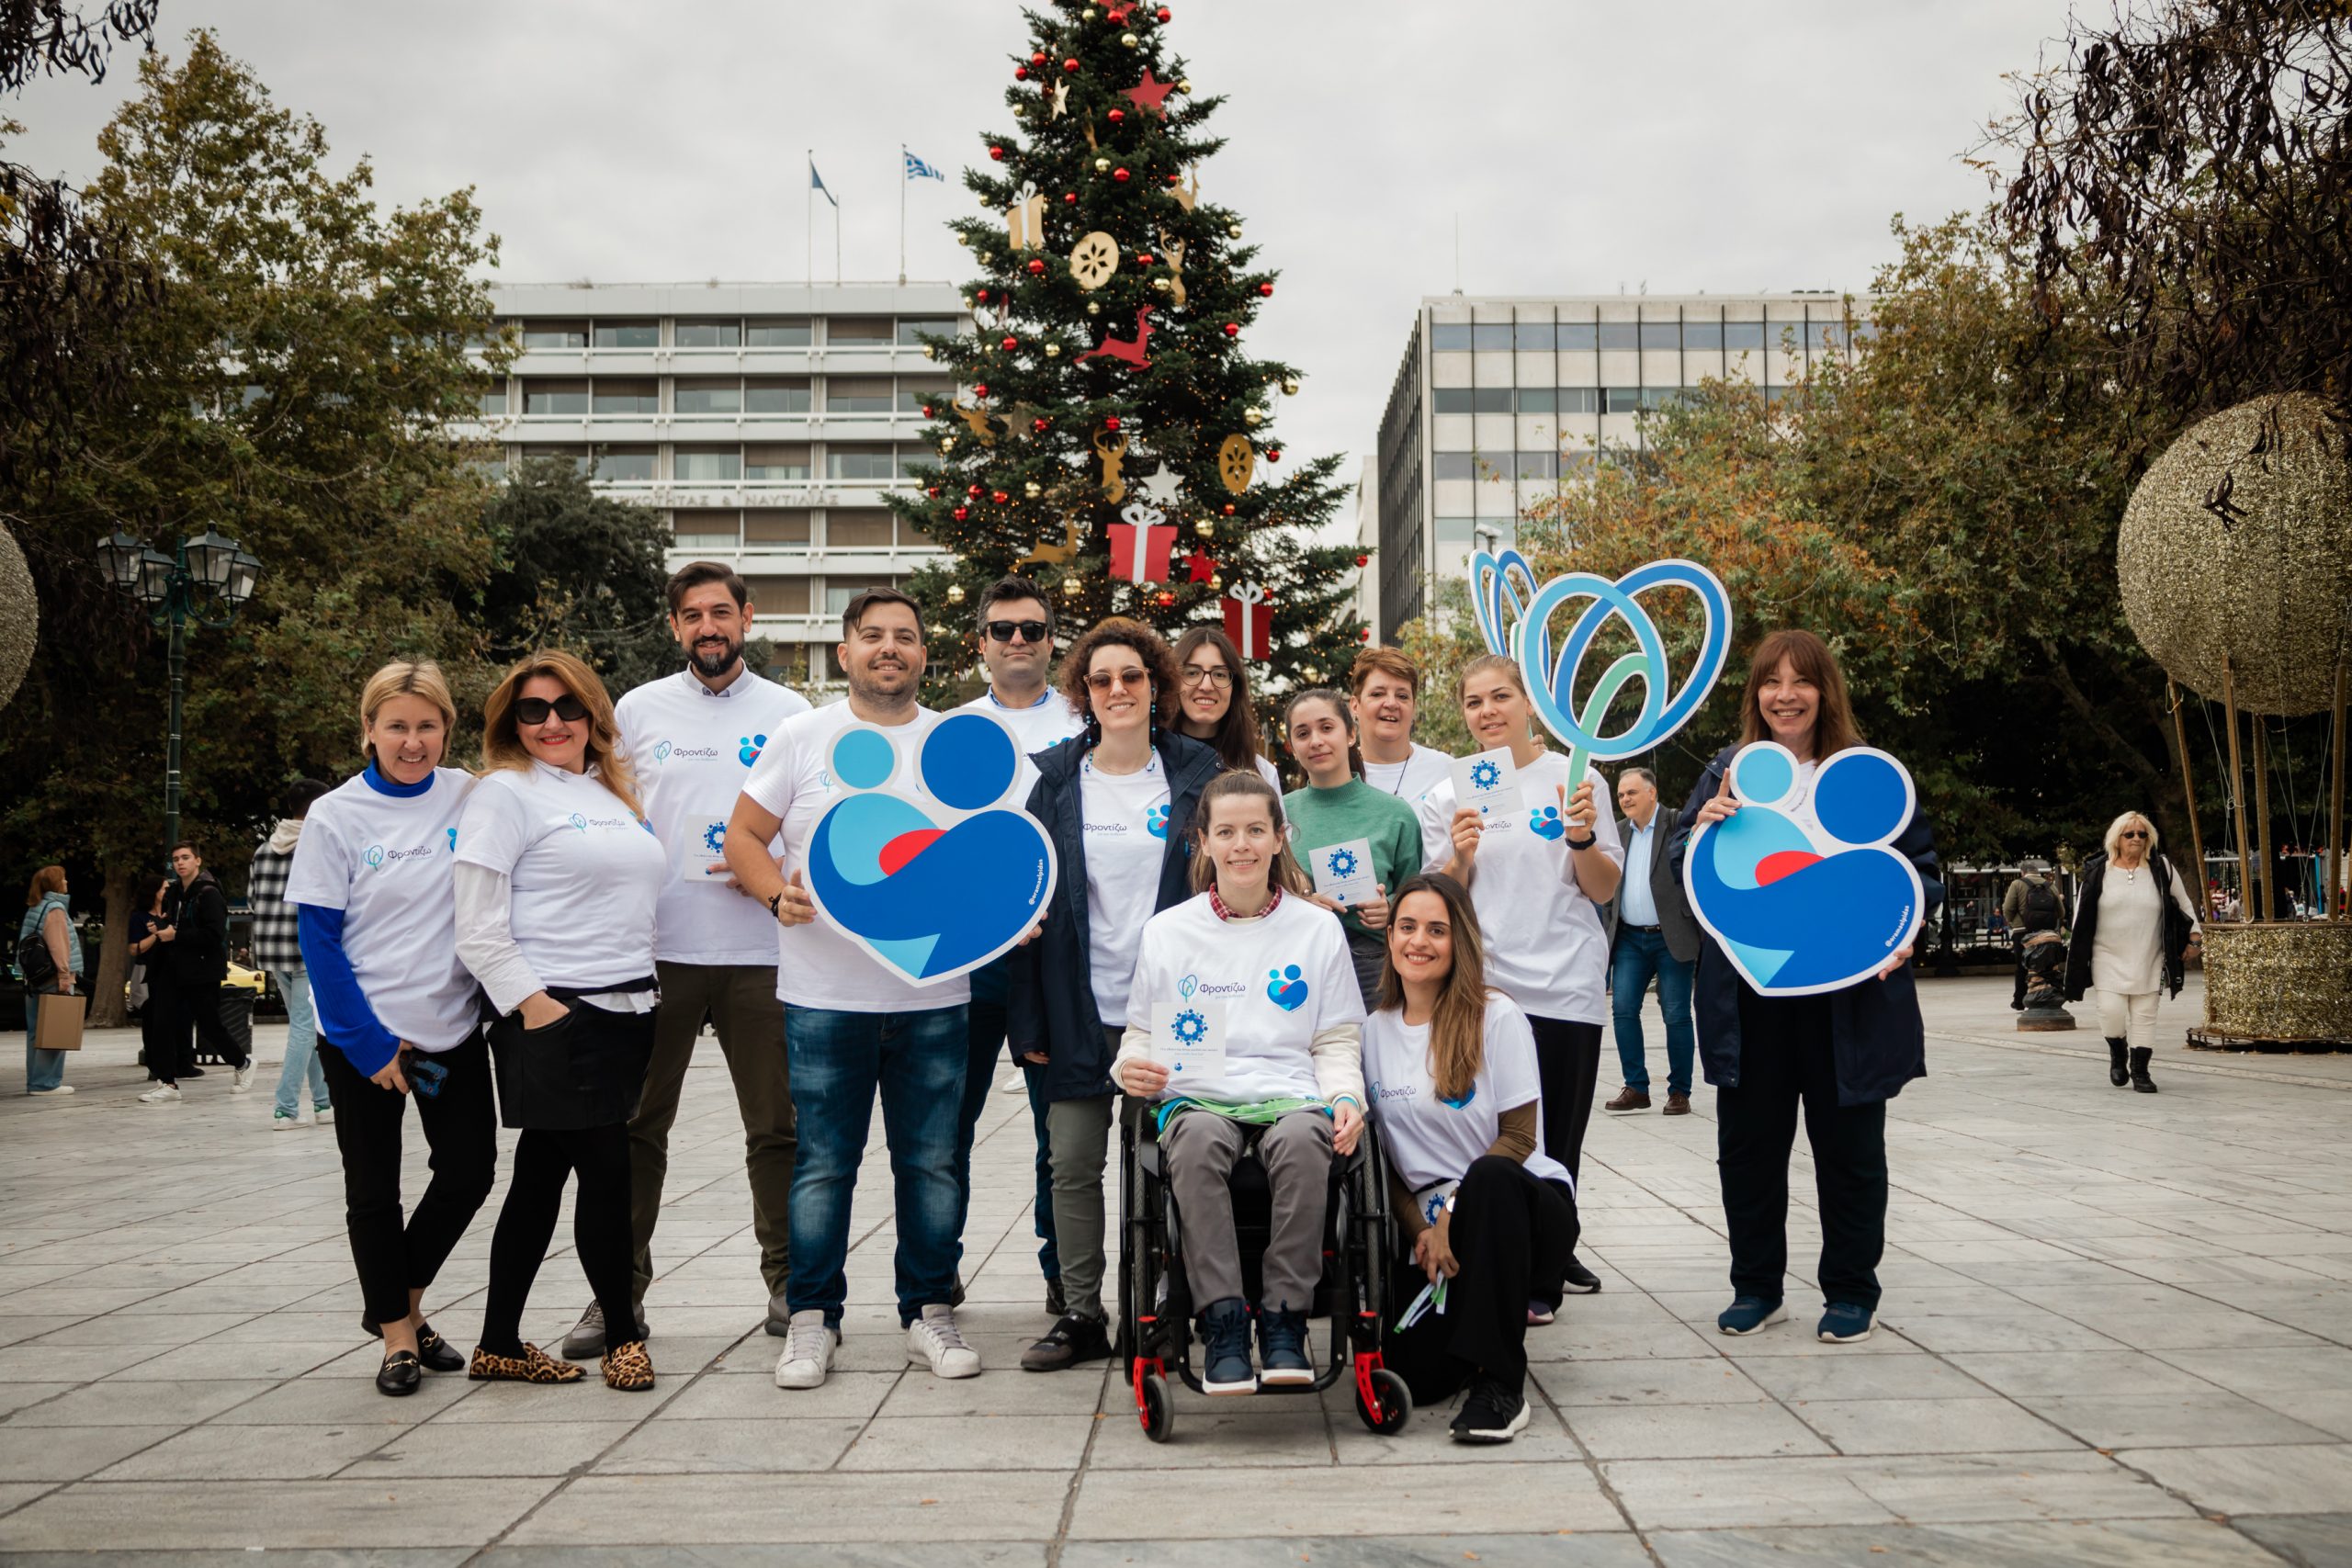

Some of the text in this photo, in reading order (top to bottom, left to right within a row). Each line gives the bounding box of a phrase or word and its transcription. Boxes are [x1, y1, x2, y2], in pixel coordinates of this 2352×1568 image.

[673, 748, 718, 758] Φροντίζω
[1083, 822, 1127, 833] Φροντίζω
[388, 845, 432, 861] Φροντίζω
[1028, 859, 1044, 906] @oramaelpidas
[1884, 905, 1910, 948] @oramaelpidas
[1200, 982, 1246, 996] Φροντίζω
[1380, 1086, 1417, 1100] Φροντίζω
